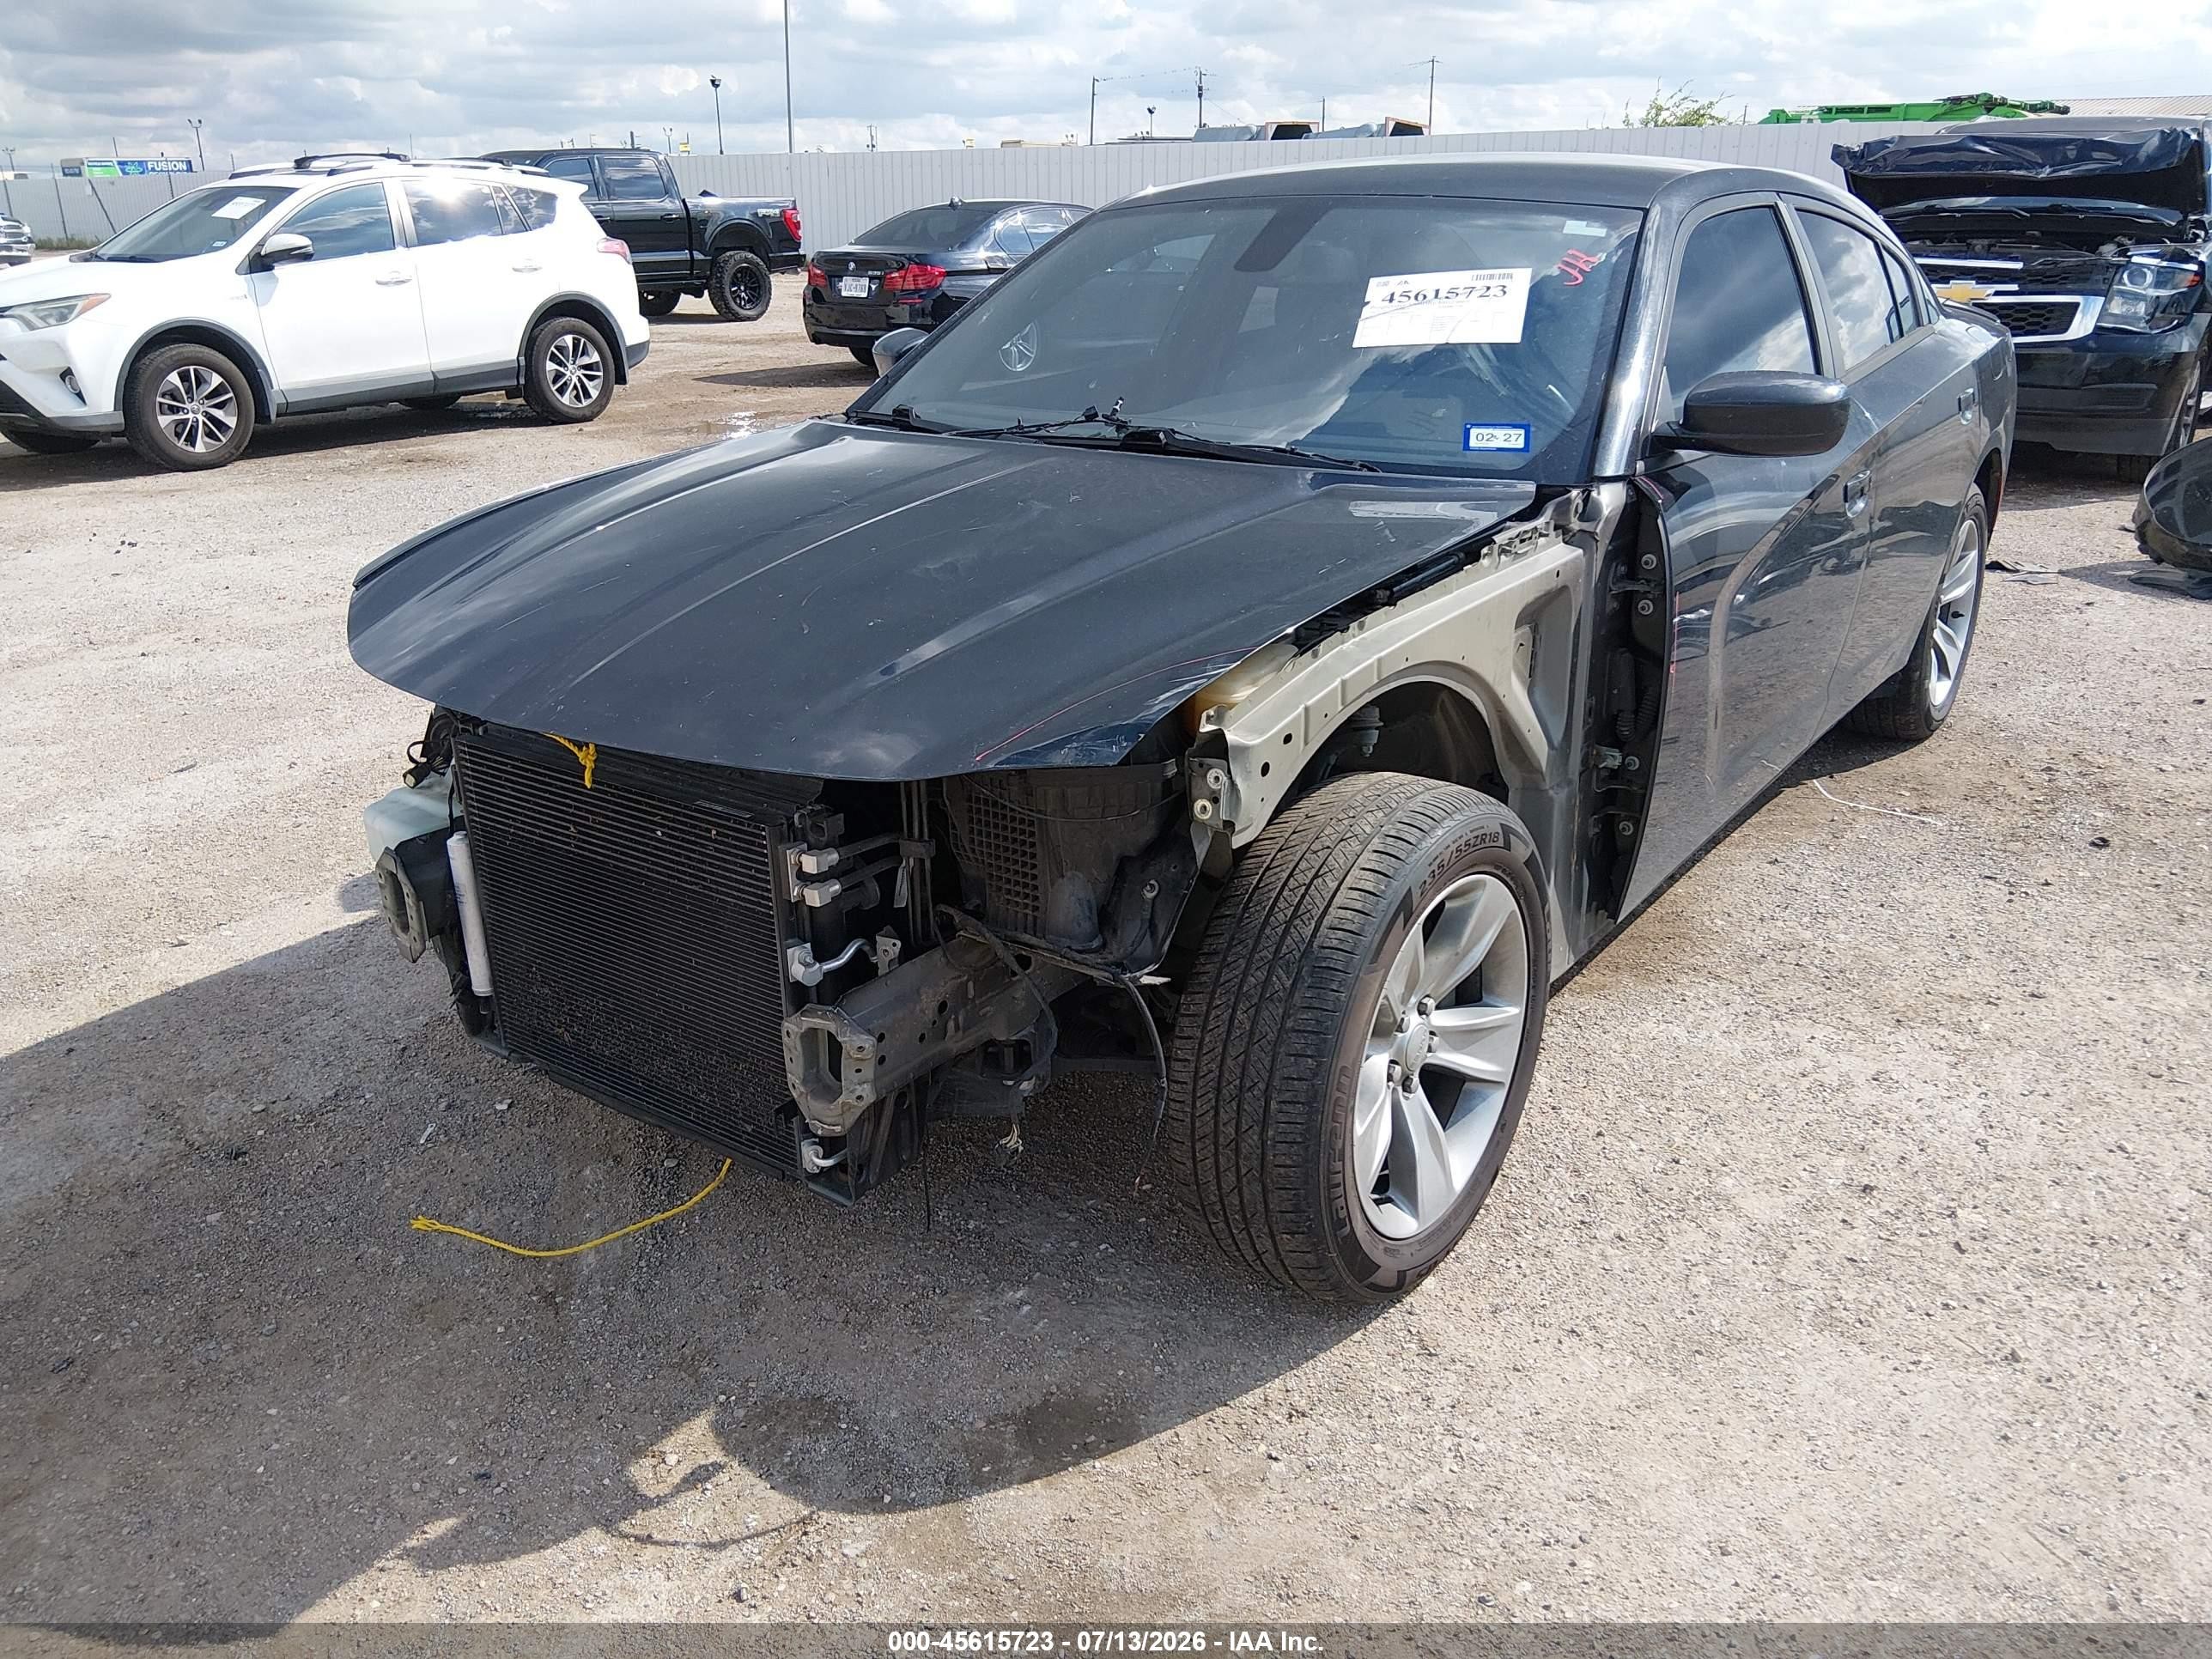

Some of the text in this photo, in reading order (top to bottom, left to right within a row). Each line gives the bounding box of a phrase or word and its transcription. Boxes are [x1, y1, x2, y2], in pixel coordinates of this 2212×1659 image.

[147, 161, 187, 171] FUSION
[1381, 284, 1508, 304] 45615723
[1476, 433, 1522, 442] 02 27
[1419, 831, 1501, 896] 235/55ZR18
